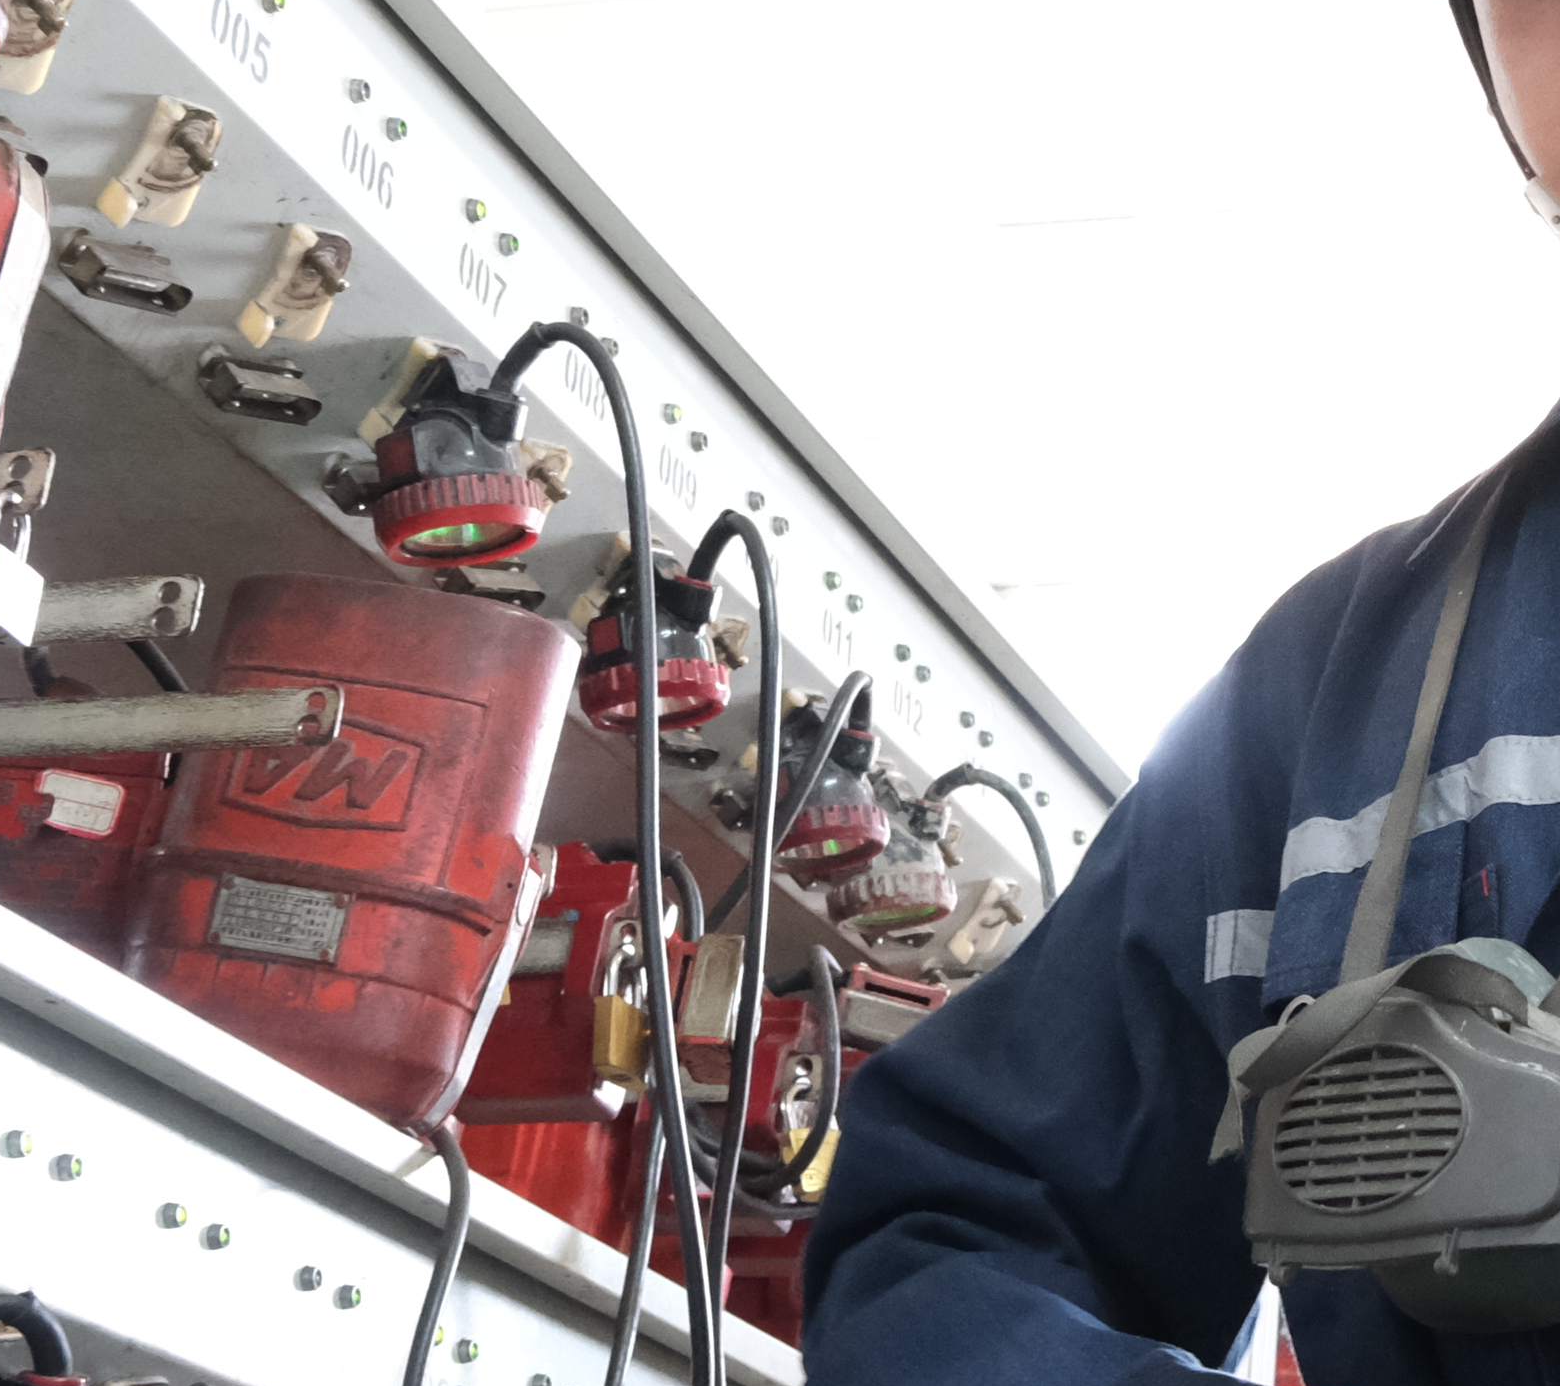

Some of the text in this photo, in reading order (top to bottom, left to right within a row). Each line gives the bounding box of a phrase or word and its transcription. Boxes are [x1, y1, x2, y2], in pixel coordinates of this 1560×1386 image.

[342, 124, 394, 210] 006
[459, 242, 508, 318] 007
[564, 349, 608, 422] 008
[659, 444, 698, 511] 009
[822, 609, 854, 667] 011
[893, 680, 924, 738] 012
